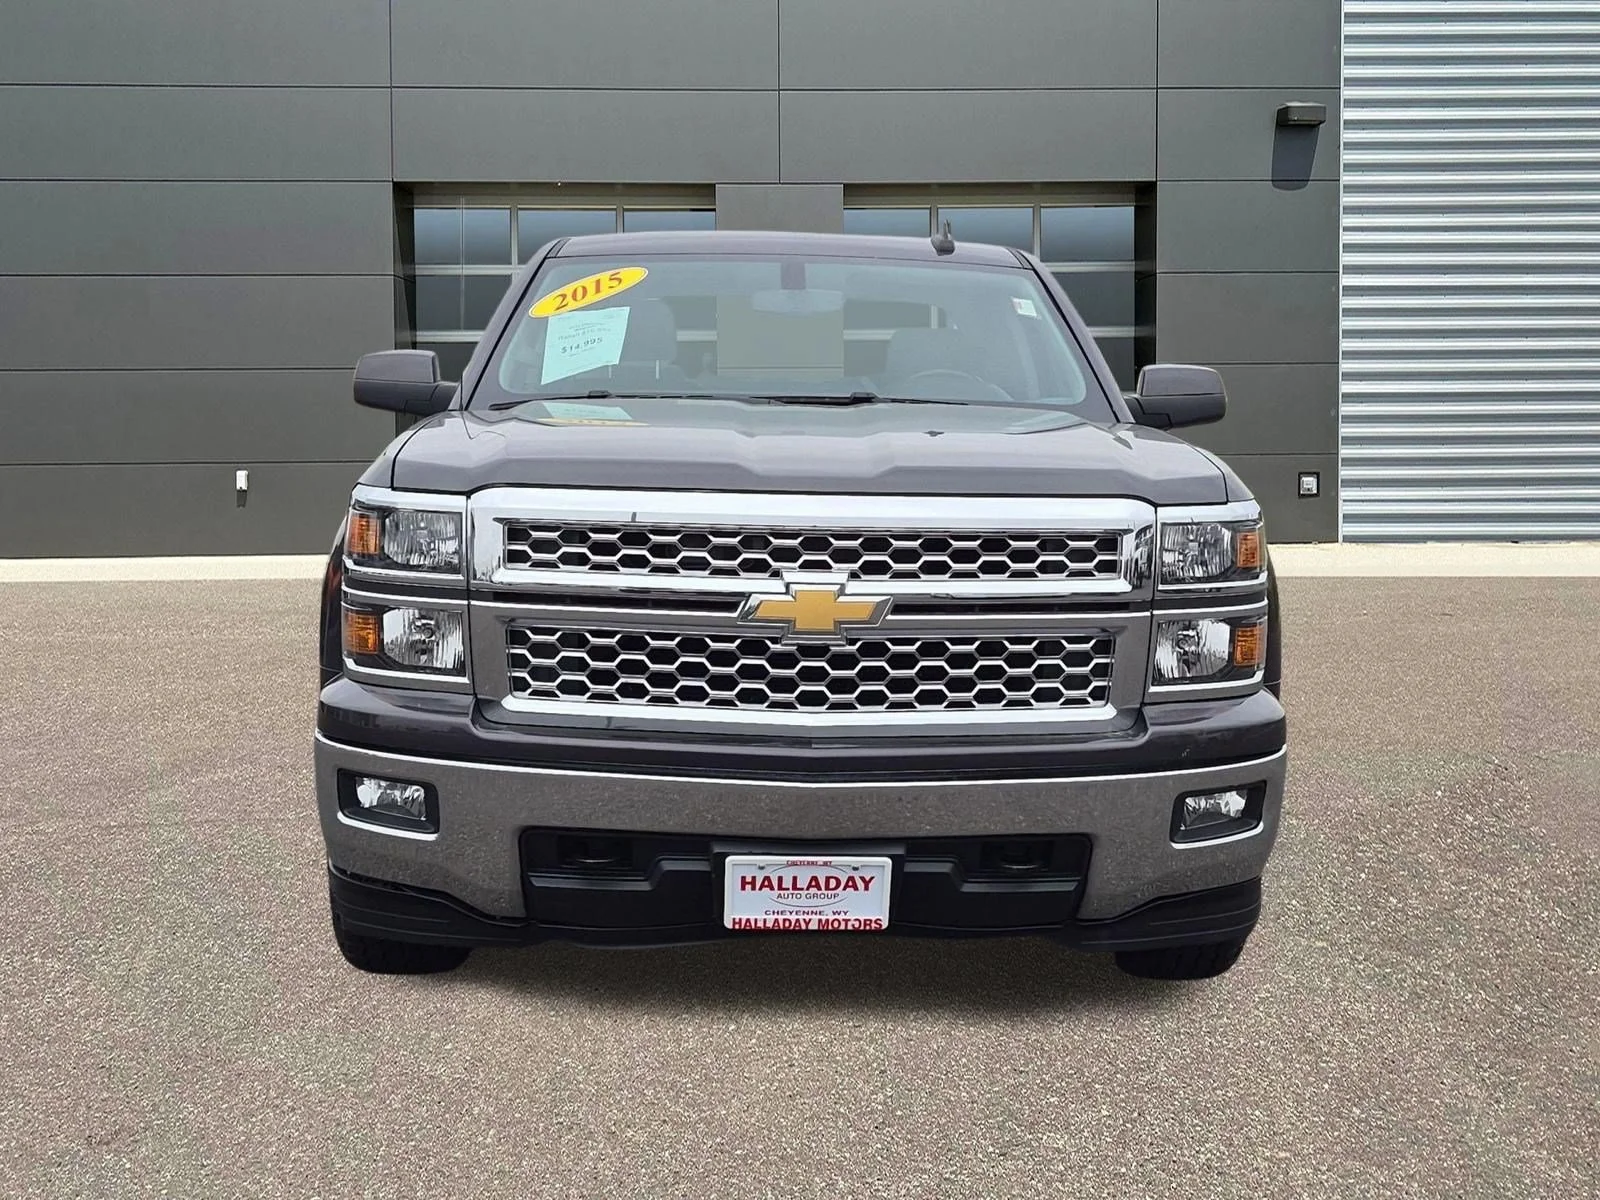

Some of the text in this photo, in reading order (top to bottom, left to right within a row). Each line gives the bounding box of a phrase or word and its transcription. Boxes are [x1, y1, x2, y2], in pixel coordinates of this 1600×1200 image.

[552, 271, 623, 311] 2015
[740, 875, 876, 892] HALLADAY
[776, 892, 840, 900] AUTO GROUP
[831, 909, 850, 917] WY
[732, 917, 884, 931] HALLADAY MOTORS
